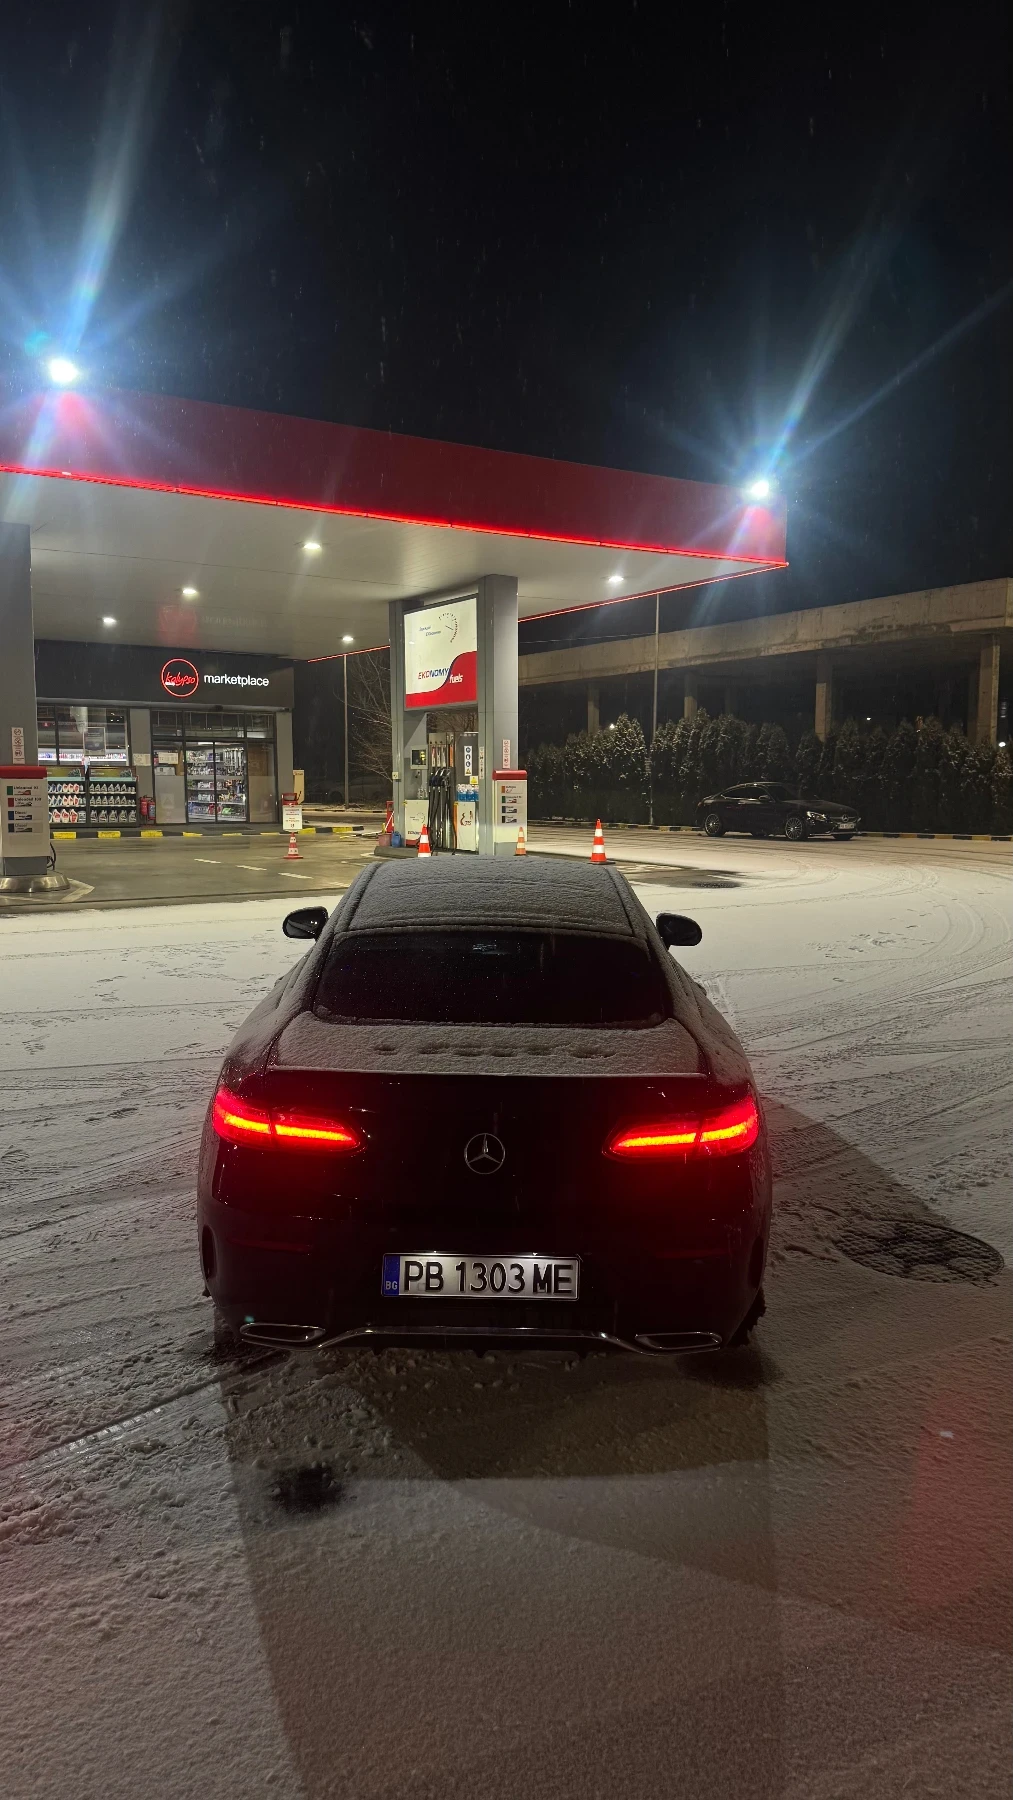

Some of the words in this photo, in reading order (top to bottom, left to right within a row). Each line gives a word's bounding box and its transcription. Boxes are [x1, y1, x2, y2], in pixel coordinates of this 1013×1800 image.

[417, 667, 450, 680] EKONOMY
[449, 673, 464, 684] fuels
[204, 674, 270, 687] marketplace
[403, 1260, 444, 1292] PB
[455, 1261, 526, 1293] 1303
[532, 1263, 573, 1294] ME
[385, 1280, 398, 1290] BG
